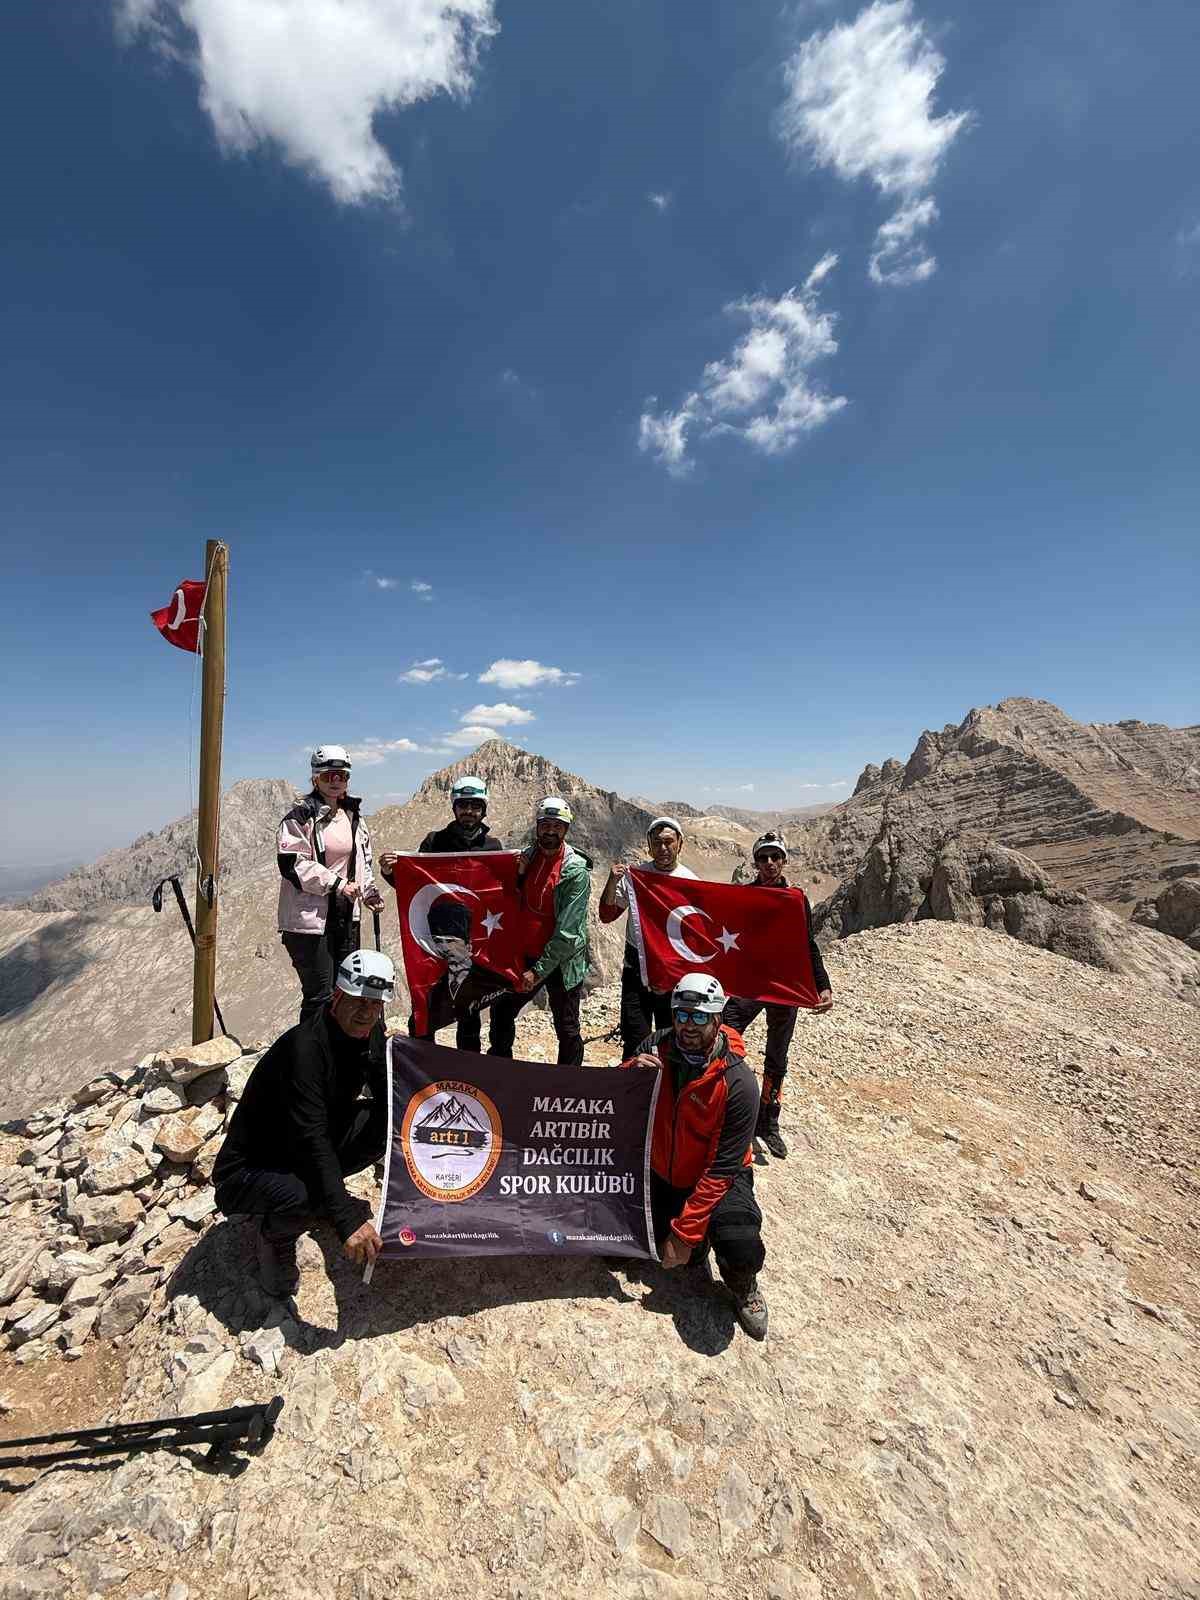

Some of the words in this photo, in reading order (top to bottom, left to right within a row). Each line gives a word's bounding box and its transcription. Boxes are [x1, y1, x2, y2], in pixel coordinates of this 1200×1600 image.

[436, 1081, 479, 1097] MAZAKA
[532, 1096, 615, 1115] MAZAKA
[529, 1119, 611, 1139] ARTIBİR
[522, 1143, 615, 1166] DAĞCILIK
[499, 1174, 552, 1195] SPOR
[555, 1171, 635, 1195] KULÜBÜ
